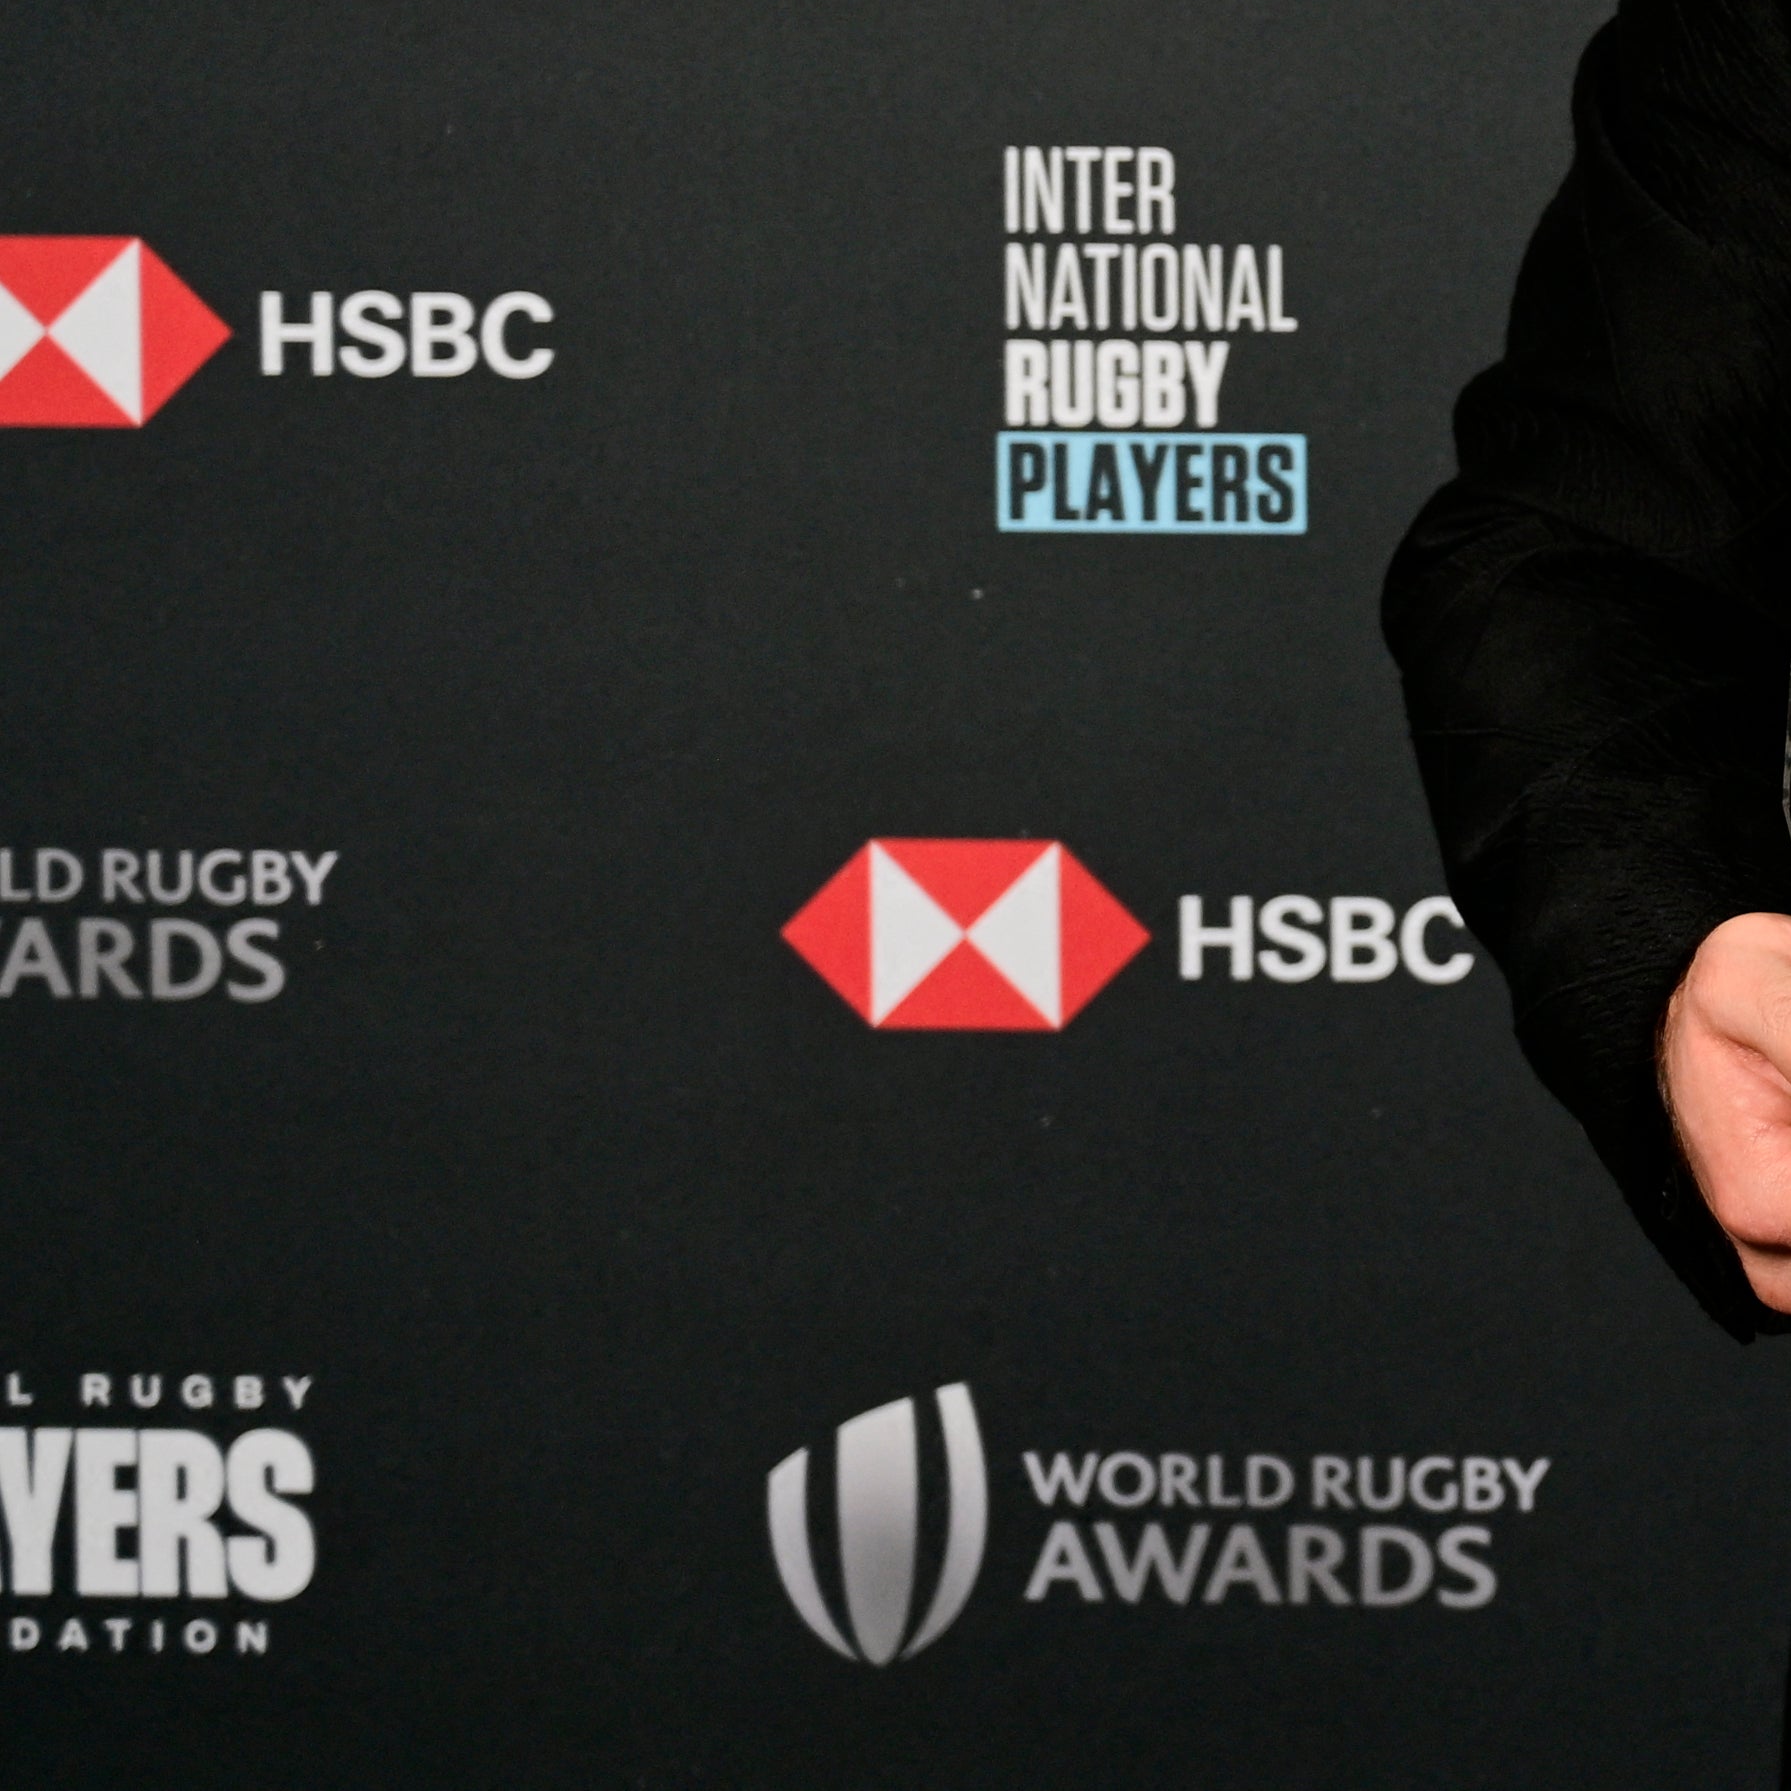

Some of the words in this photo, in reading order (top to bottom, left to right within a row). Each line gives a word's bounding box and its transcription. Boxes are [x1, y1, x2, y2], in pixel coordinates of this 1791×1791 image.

[1005, 147, 1174, 234] INTER
[1006, 243, 1297, 331] NATIONAL
[261, 291, 553, 378] HSBC
[1005, 340, 1228, 427] RUGBY
[1009, 442, 1294, 524] PLAYERS
[103, 849, 337, 904] RUGBY
[0, 918, 284, 1001] ARDS
[1180, 895, 1473, 983] HSBC
[82, 1373, 311, 1408] RUGBY
[1023, 1452, 1293, 1507] WORLD
[1314, 1456, 1549, 1511] RUGBY
[1026, 1521, 1496, 1607] AWARDS
[11, 1617, 267, 1653] DATION
